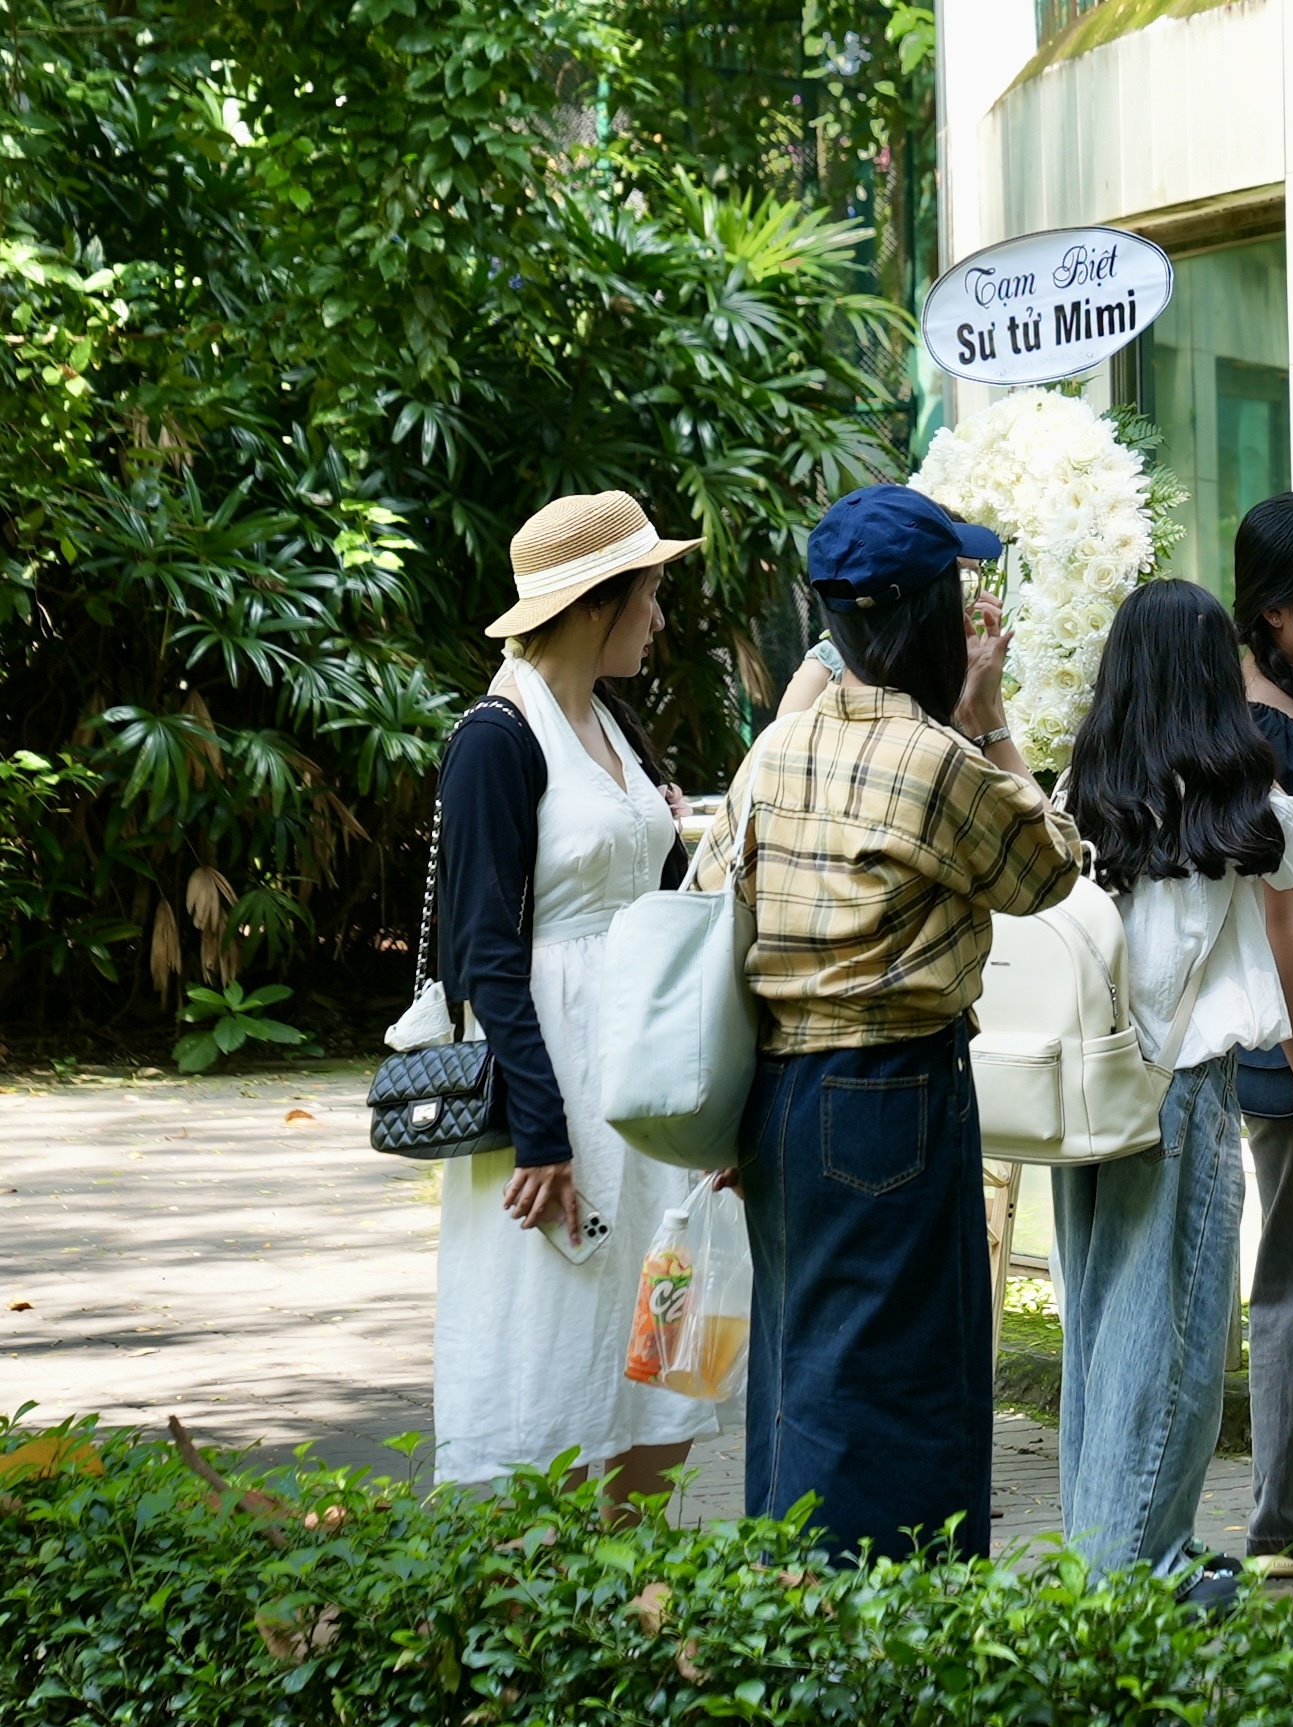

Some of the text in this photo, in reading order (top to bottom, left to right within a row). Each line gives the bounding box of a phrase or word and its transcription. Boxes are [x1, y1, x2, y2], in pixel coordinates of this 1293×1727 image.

[965, 244, 1119, 310] Tạm Biệt
[956, 320, 997, 365] Sư
[1007, 306, 1042, 355] tử
[1054, 289, 1136, 346] Mimi
[650, 1280, 689, 1324] C2
